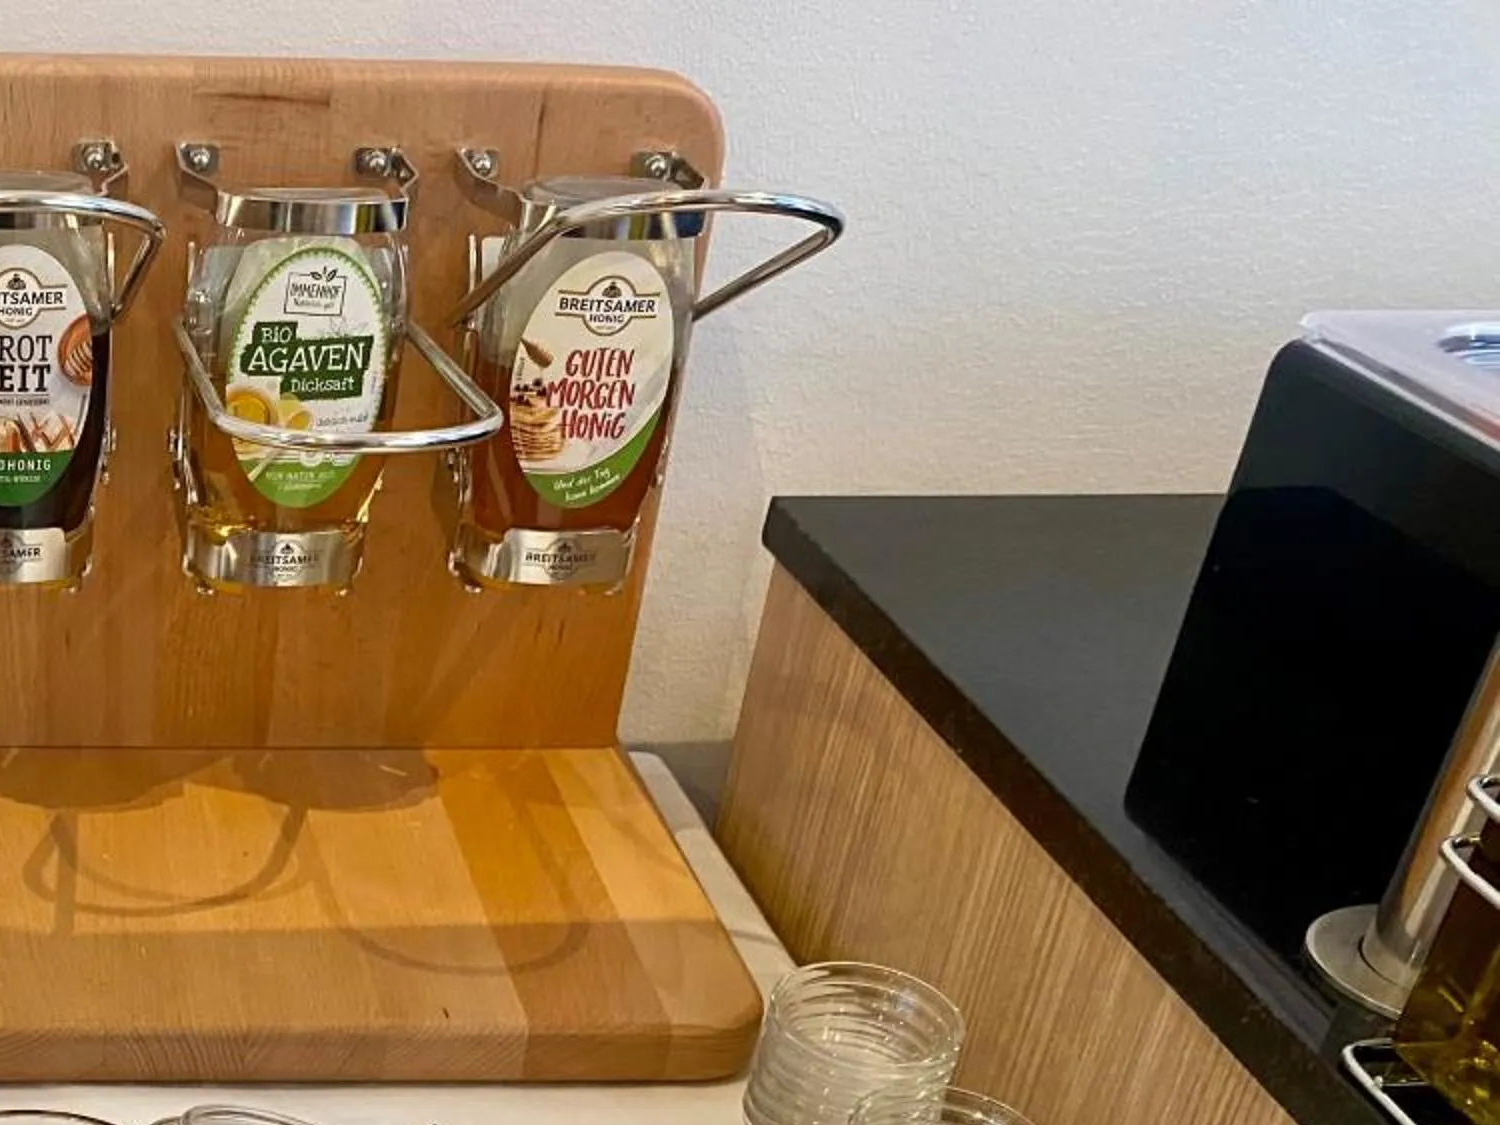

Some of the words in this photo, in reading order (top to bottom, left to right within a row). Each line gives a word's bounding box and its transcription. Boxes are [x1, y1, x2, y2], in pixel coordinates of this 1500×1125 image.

[560, 297, 655, 313] BREITSAMER
[590, 314, 624, 323] HONIG
[247, 342, 365, 372] AGAVEN
[565, 347, 635, 382] GUTEN
[291, 375, 355, 392] Dicksaft
[546, 377, 635, 410] MORGEN
